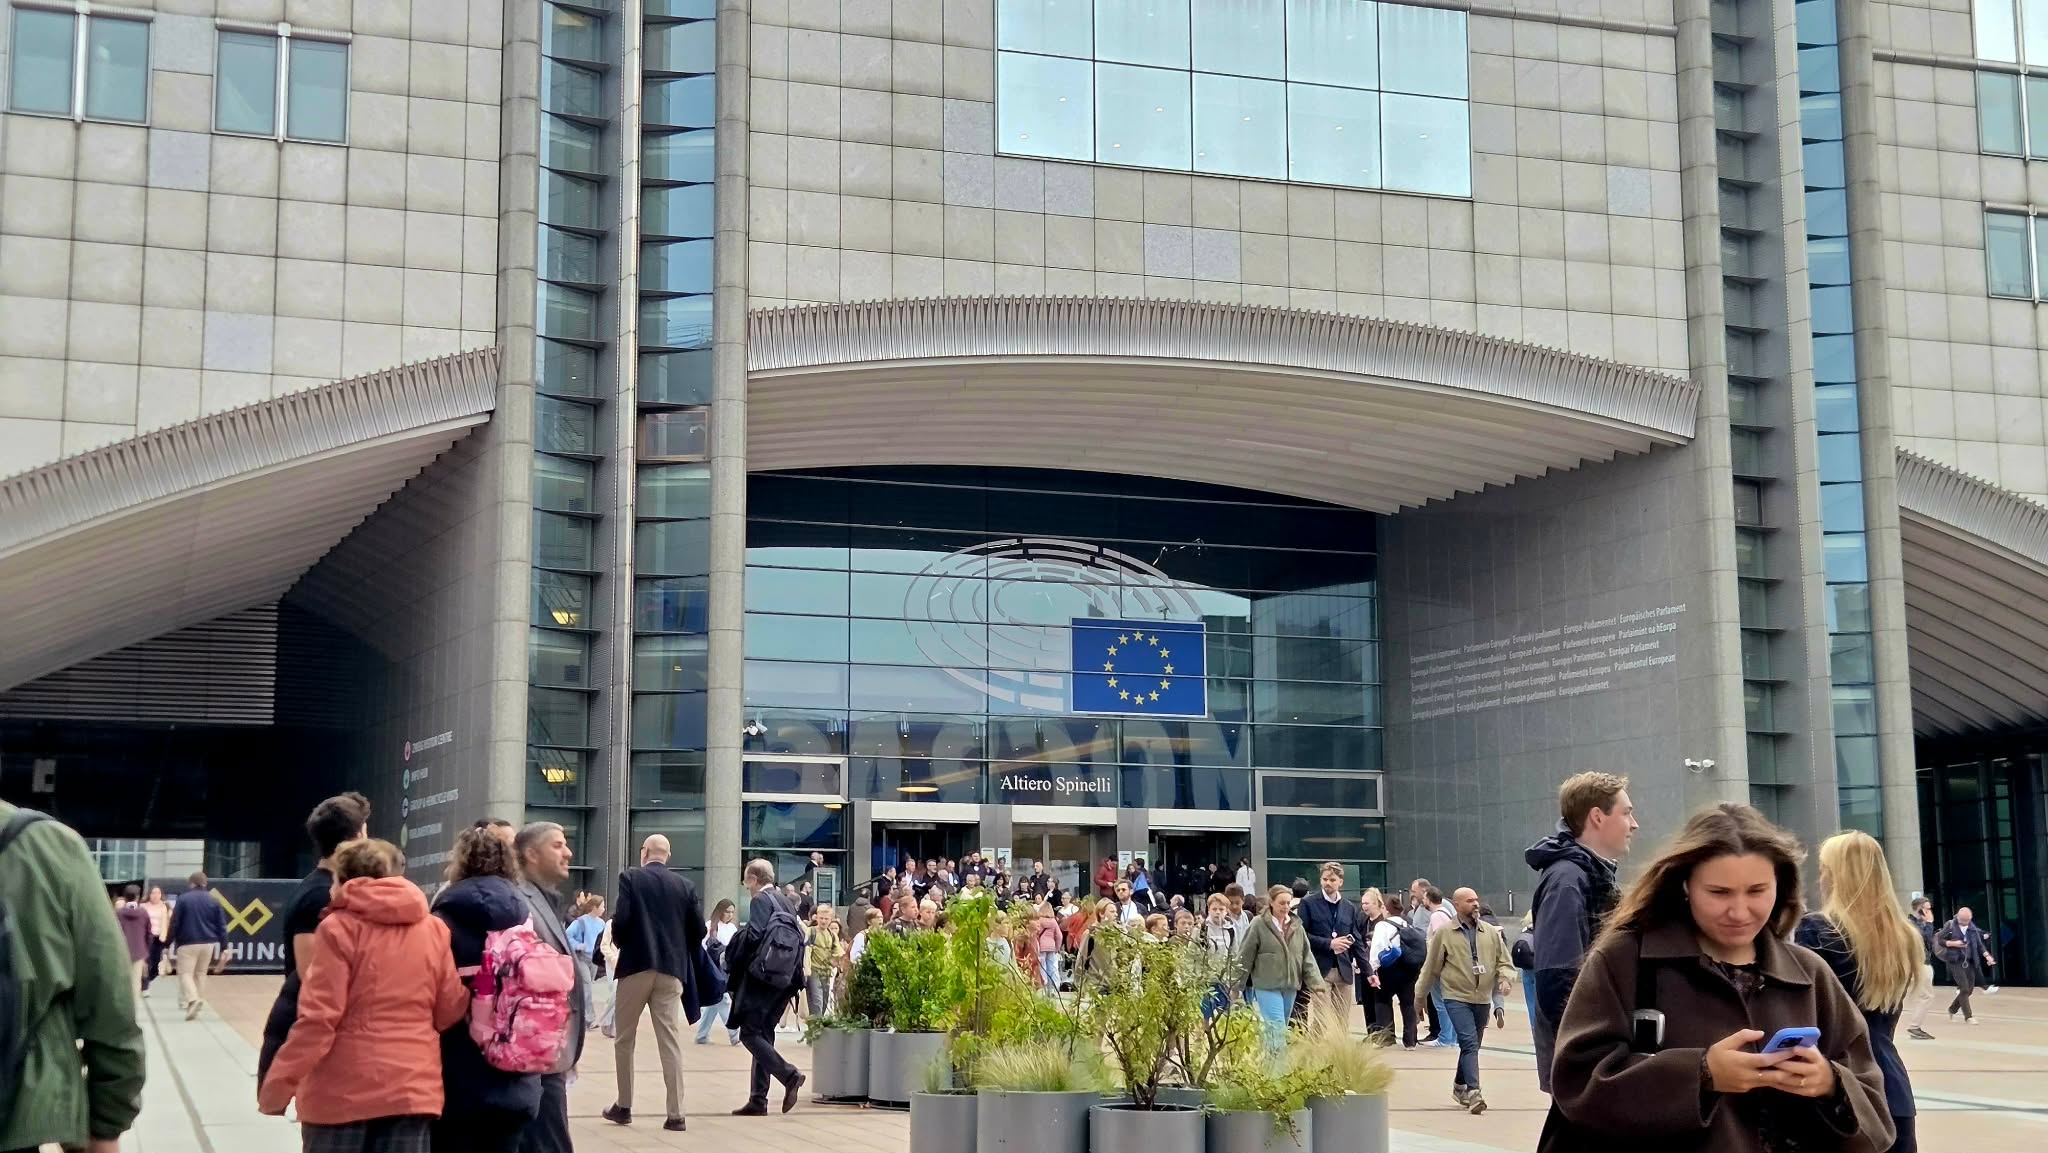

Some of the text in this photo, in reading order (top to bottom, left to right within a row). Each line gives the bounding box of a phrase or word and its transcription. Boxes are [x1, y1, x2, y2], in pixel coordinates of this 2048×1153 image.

[1619, 603, 1686, 623] Europäisches Parlament
[1630, 641, 1659, 652] Parlament
[1000, 775, 1111, 795] Altiero Spinelli
